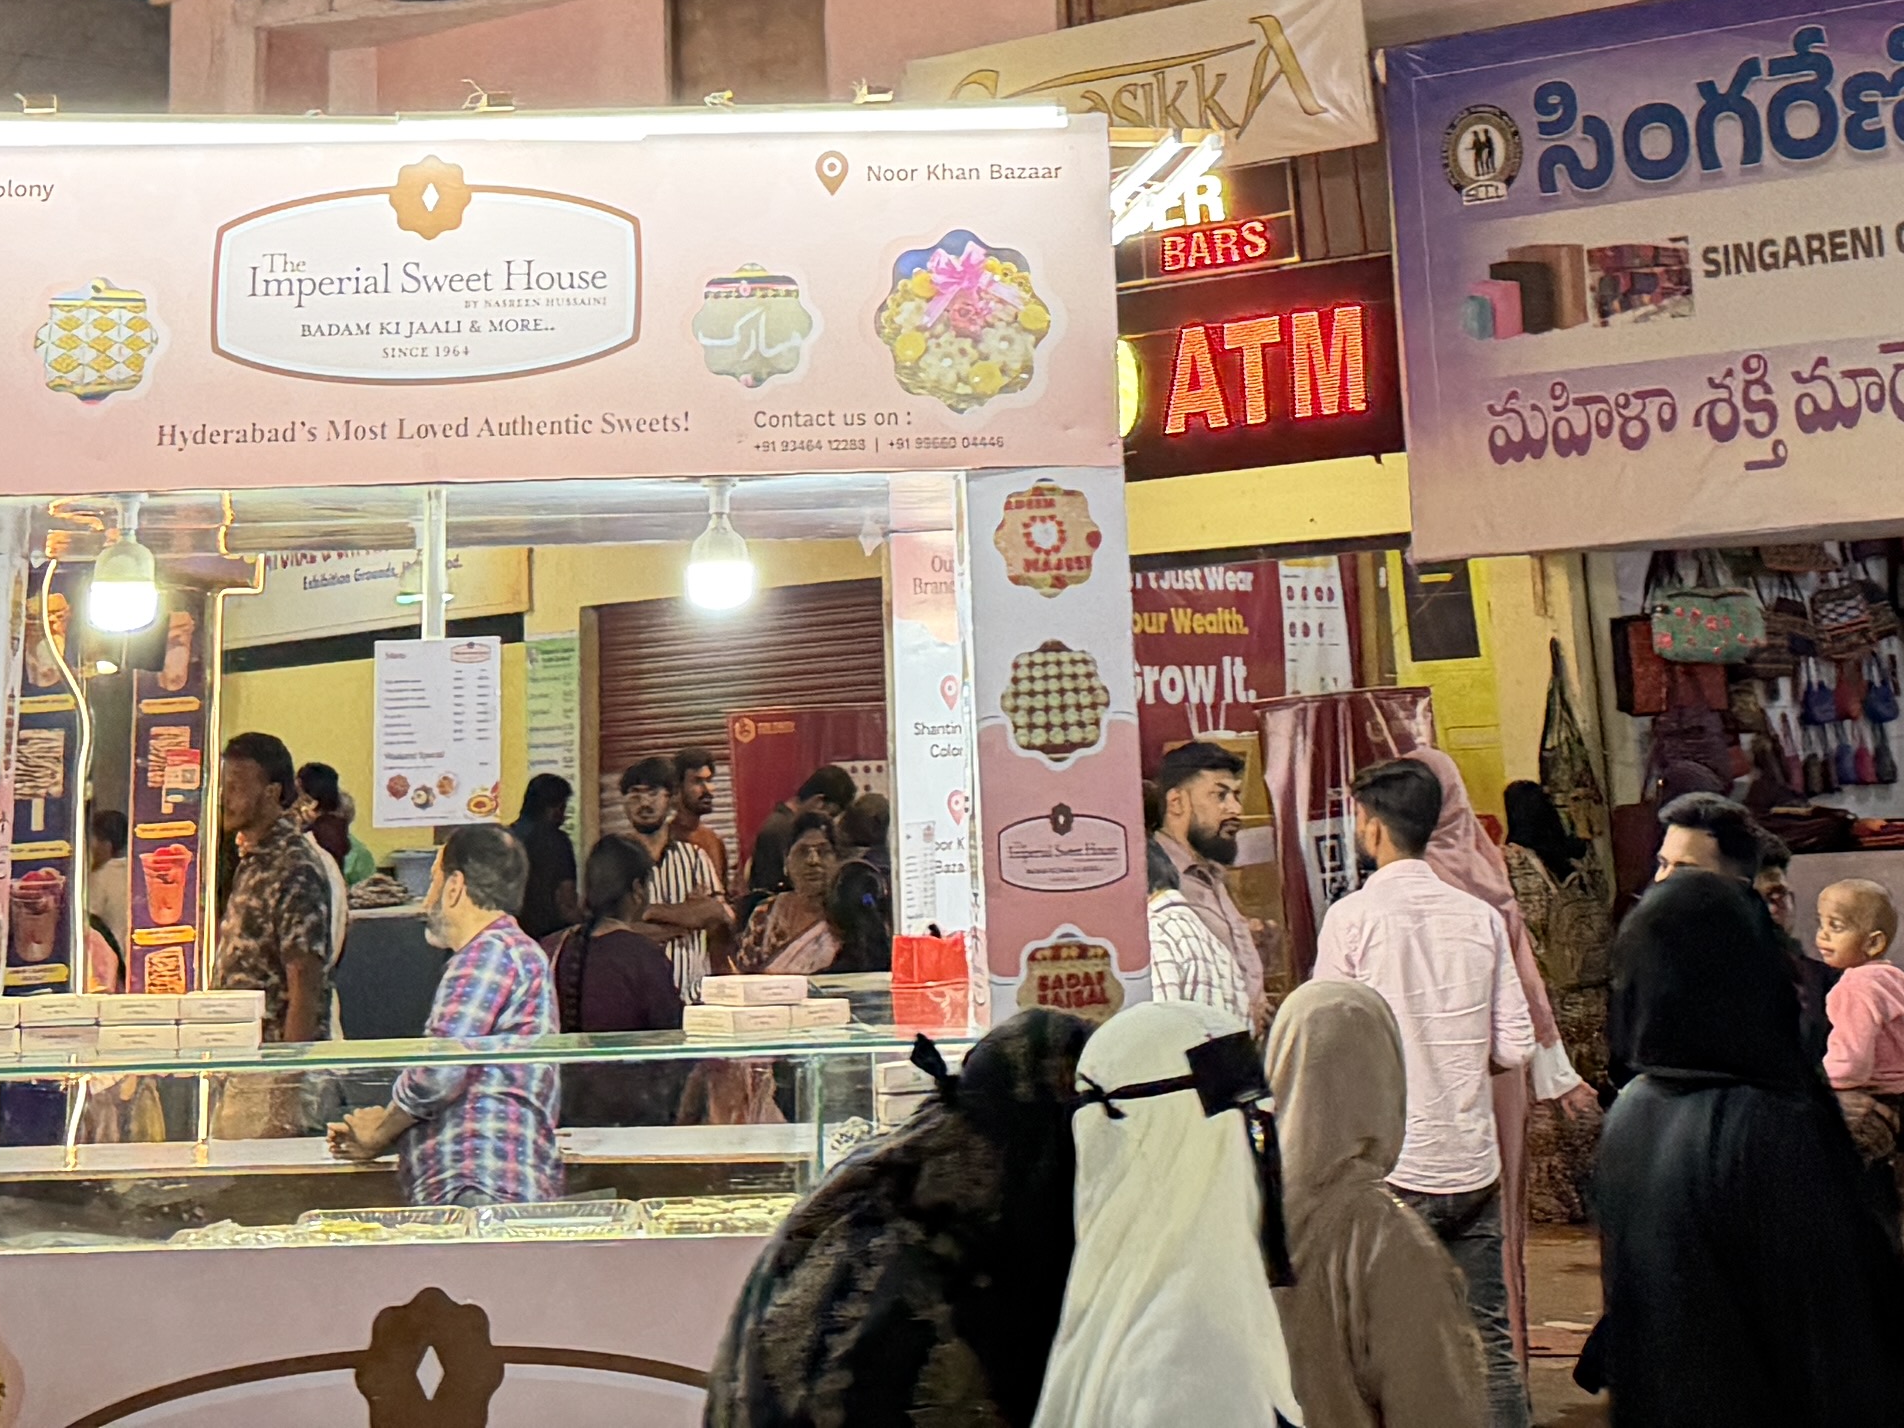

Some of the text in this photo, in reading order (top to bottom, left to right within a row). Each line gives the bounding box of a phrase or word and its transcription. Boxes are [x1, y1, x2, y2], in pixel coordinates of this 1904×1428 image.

[867, 163, 1062, 182] Noor Khan Bazaar
[1163, 220, 1268, 272] BARS
[1701, 225, 1886, 280] SINGARENI
[262, 253, 307, 273] The
[247, 259, 608, 308] Imperial Sweet House
[464, 299, 481, 309] BY
[301, 318, 556, 338] BADAM KI JAALI & MORE..
[382, 345, 471, 359] SINCE 1964
[1163, 304, 1370, 437] ATM
[753, 409, 836, 429] Contact
[843, 413, 867, 426] us
[874, 413, 899, 426] on
[1488, 380, 1677, 466] మహిళా
[1693, 353, 1787, 471] శక్తి
[156, 411, 691, 452] Hyderabad's Most Loved Authentic Sweets!
[753, 440, 777, 452] +91
[888, 437, 911, 450] +91
[930, 555, 955, 574] Ou
[1159, 567, 1204, 592] Just
[1203, 566, 1255, 592] Wear
[1131, 606, 1250, 636] our Wealth.
[1221, 655, 1257, 704] It.
